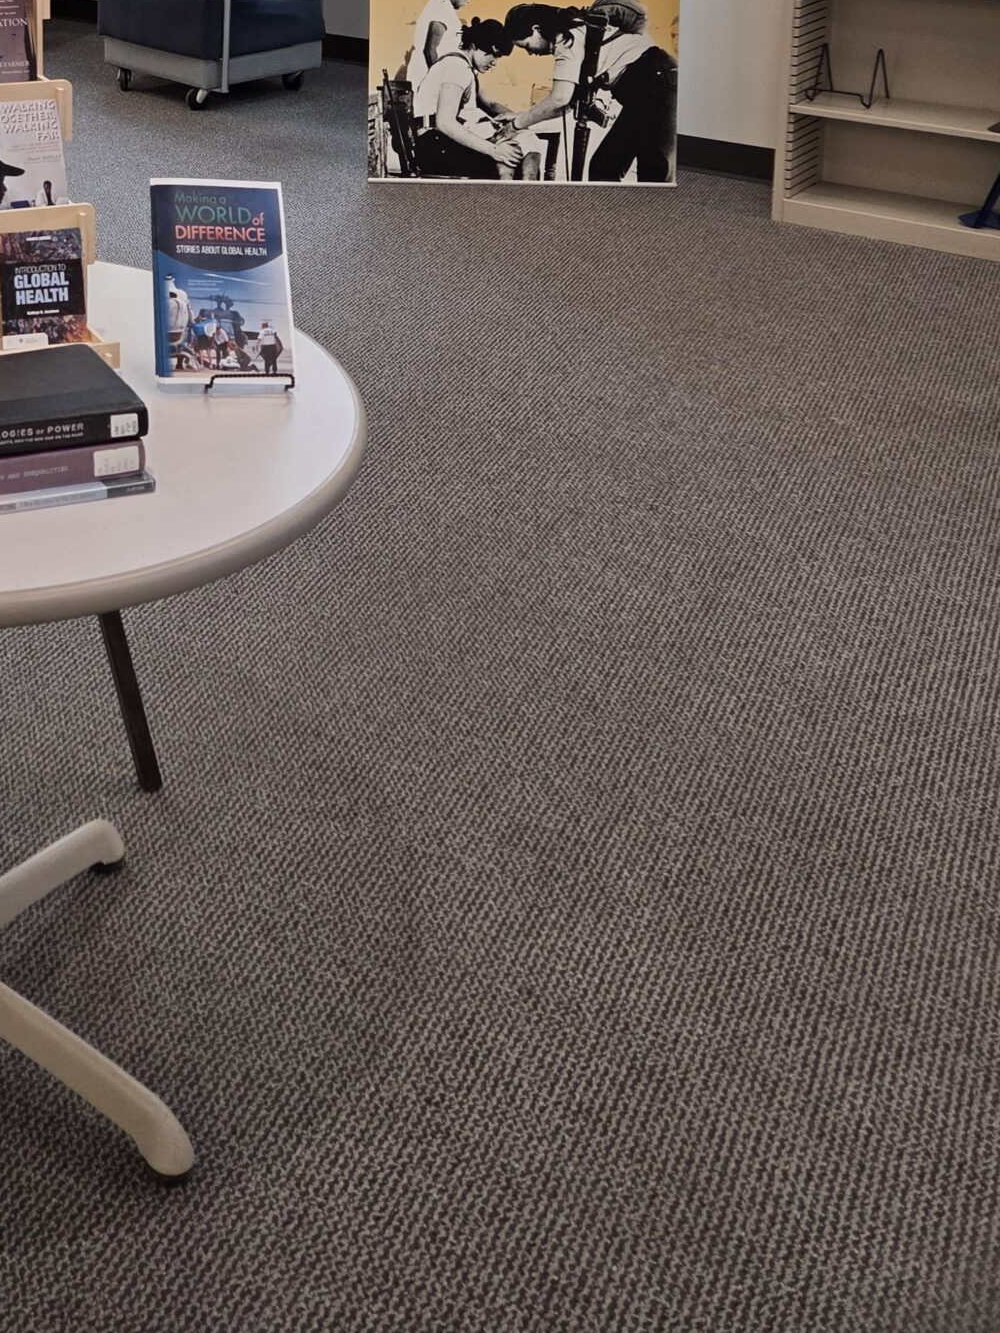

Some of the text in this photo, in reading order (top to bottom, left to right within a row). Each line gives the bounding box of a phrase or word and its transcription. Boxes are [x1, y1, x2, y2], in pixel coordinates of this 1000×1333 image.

[2, 101, 55, 113] WALKING
[4, 121, 58, 134] WALKING
[175, 192, 226, 204] Making a
[175, 204, 264, 226] WORLD of
[175, 225, 265, 242] DIFFERENCE
[176, 244, 267, 256] STORIES ABOUT GLOBAL HEALTH
[15, 263, 66, 274] INTRODUCTION TO
[14, 272, 69, 289] GLOBAL
[16, 287, 69, 305] HEALTH
[47, 423, 84, 434] POWER
